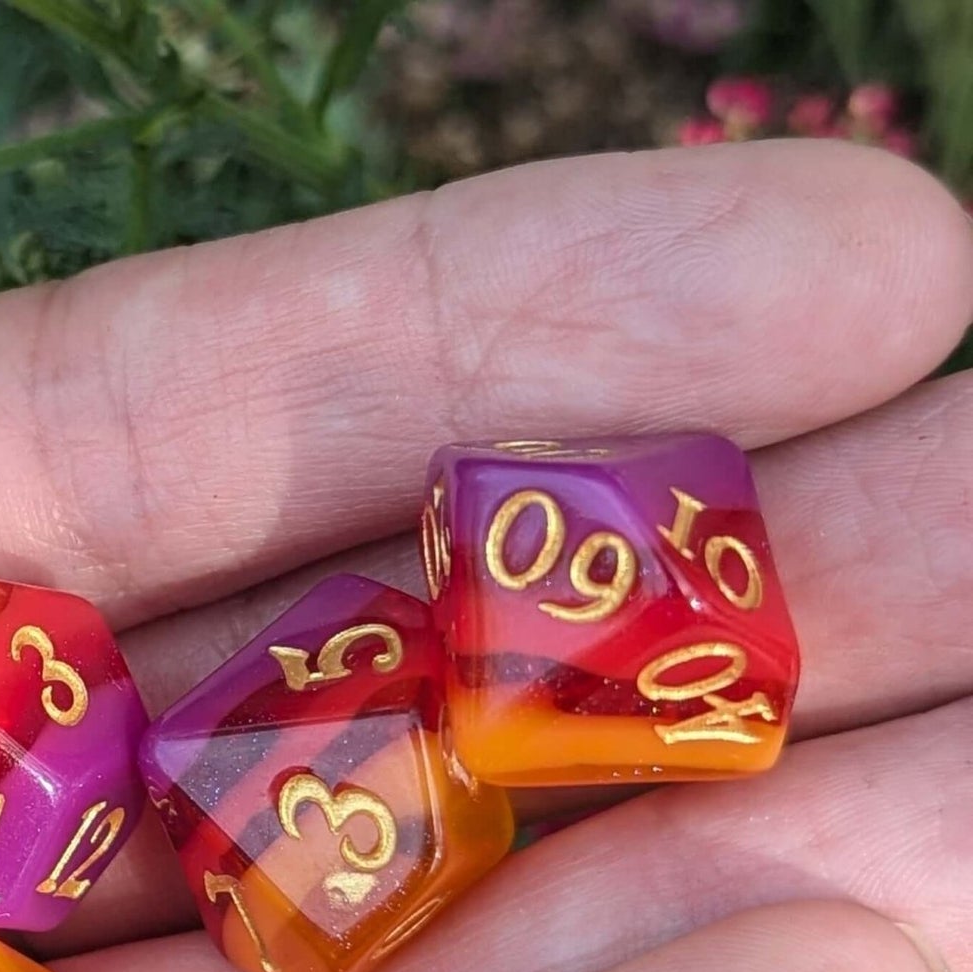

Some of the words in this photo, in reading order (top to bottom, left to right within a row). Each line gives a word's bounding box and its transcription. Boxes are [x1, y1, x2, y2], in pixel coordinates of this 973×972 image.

[656, 486, 764, 611] 10
[10, 624, 89, 727] 3
[268, 622, 403, 691] 5
[636, 641, 778, 746] 40
[35, 801, 126, 898] 12
